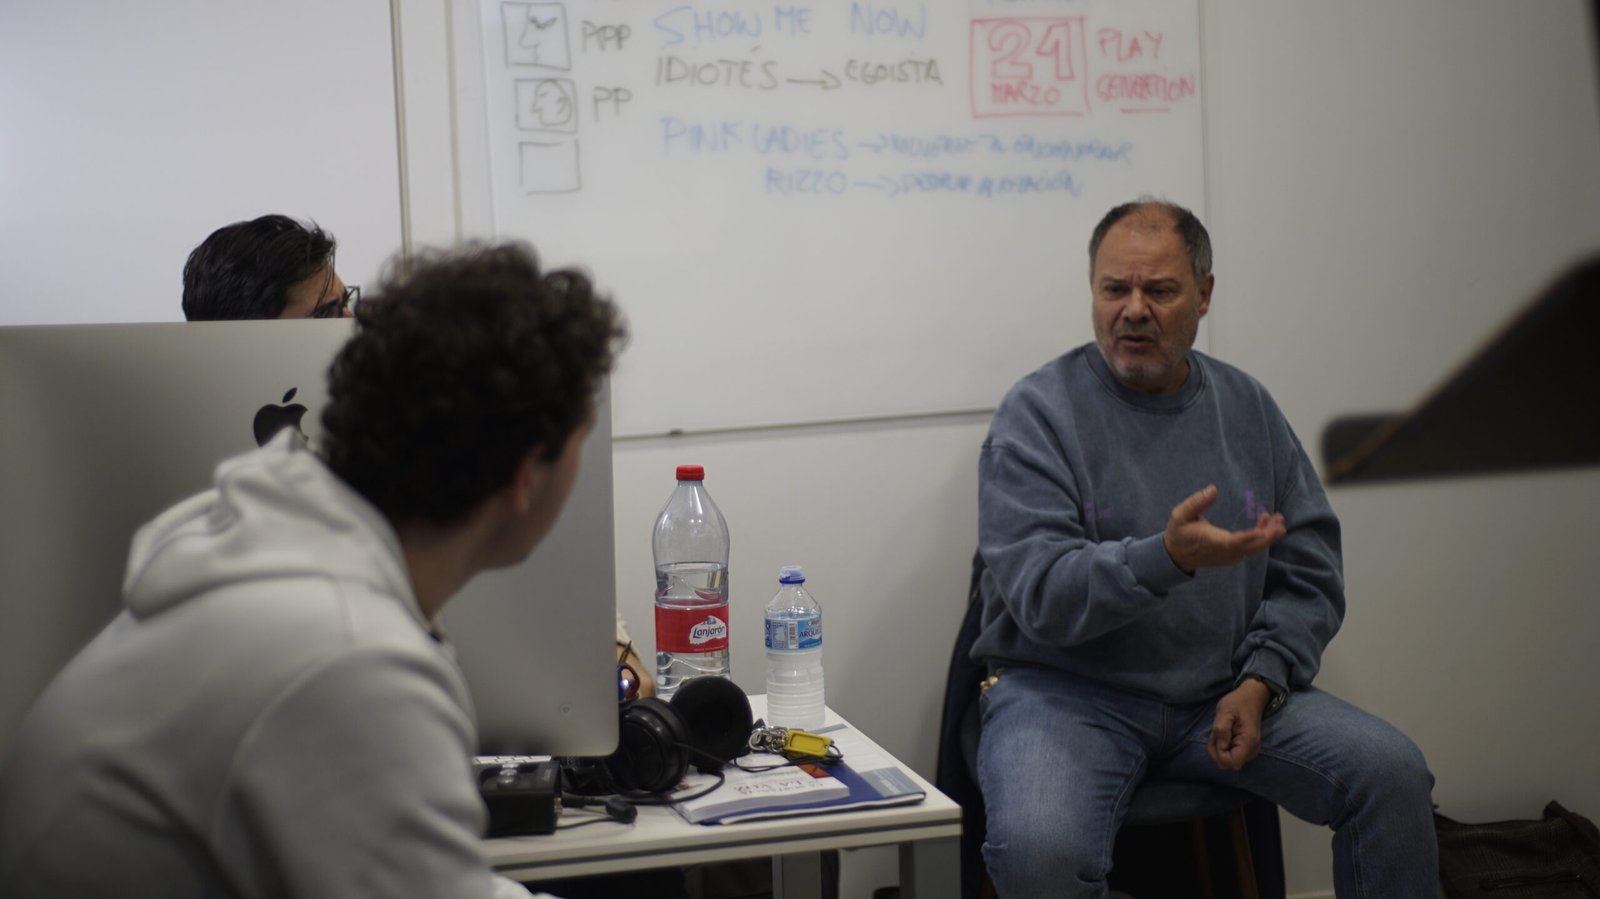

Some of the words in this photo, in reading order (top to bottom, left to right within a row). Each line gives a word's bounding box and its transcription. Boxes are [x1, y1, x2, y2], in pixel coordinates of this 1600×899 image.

[654, 6, 762, 46] SHOW
[774, 6, 813, 39] ME
[850, 3, 927, 39] NOW
[1097, 28, 1163, 62] PLAY
[844, 58, 944, 86] EGOISTA
[987, 21, 1075, 81] 24
[660, 115, 744, 155] PINK
[752, 122, 849, 160] LADIES
